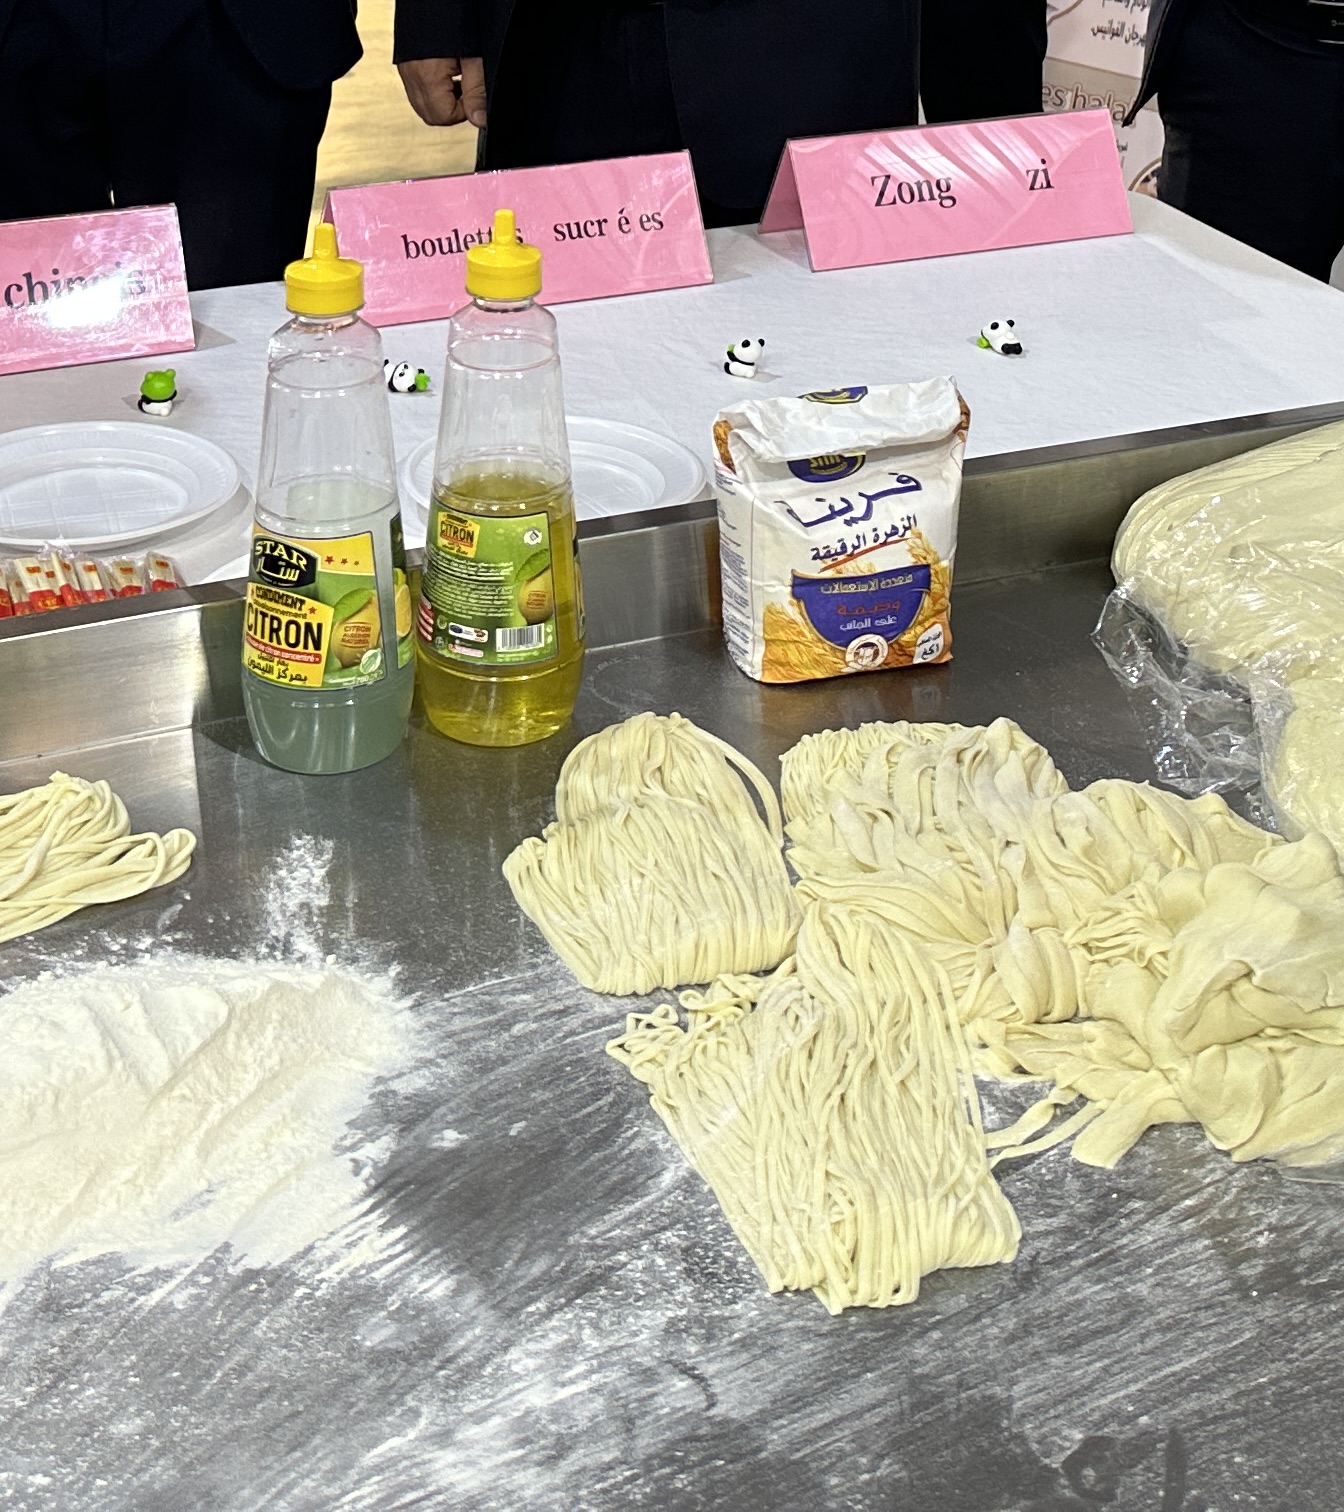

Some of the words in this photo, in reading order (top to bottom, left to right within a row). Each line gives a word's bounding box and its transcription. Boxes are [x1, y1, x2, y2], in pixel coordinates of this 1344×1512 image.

[870, 173, 957, 209] Zong
[1025, 157, 1056, 191] zi
[400, 224, 524, 259] bouletts
[872, 513, 919, 546] الزهرة
[254, 539, 308, 572] STAR
[810, 533, 868, 563] الرقيقة
[246, 601, 324, 652] CITRON
